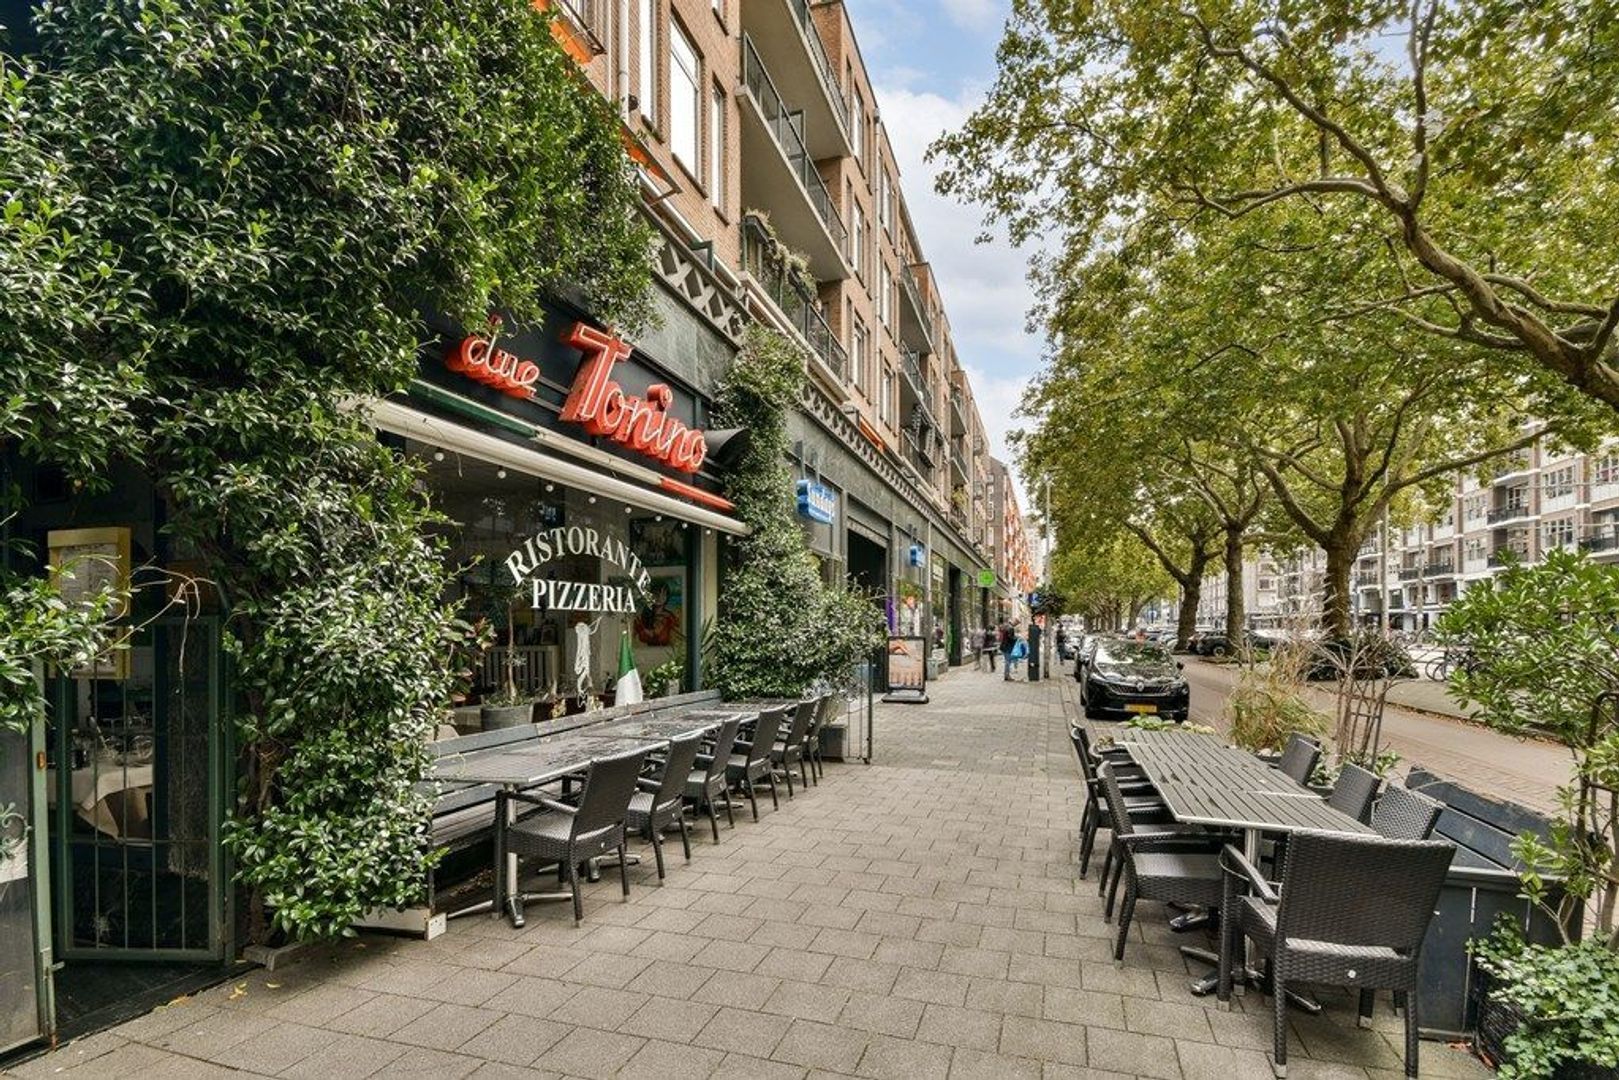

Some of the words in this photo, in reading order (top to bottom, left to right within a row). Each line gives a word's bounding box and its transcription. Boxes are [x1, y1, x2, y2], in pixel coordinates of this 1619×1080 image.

[458, 318, 540, 398] due
[561, 322, 708, 472] Tonino
[504, 526, 652, 596] RISTORANTE
[530, 578, 637, 613] PIZZERIA
